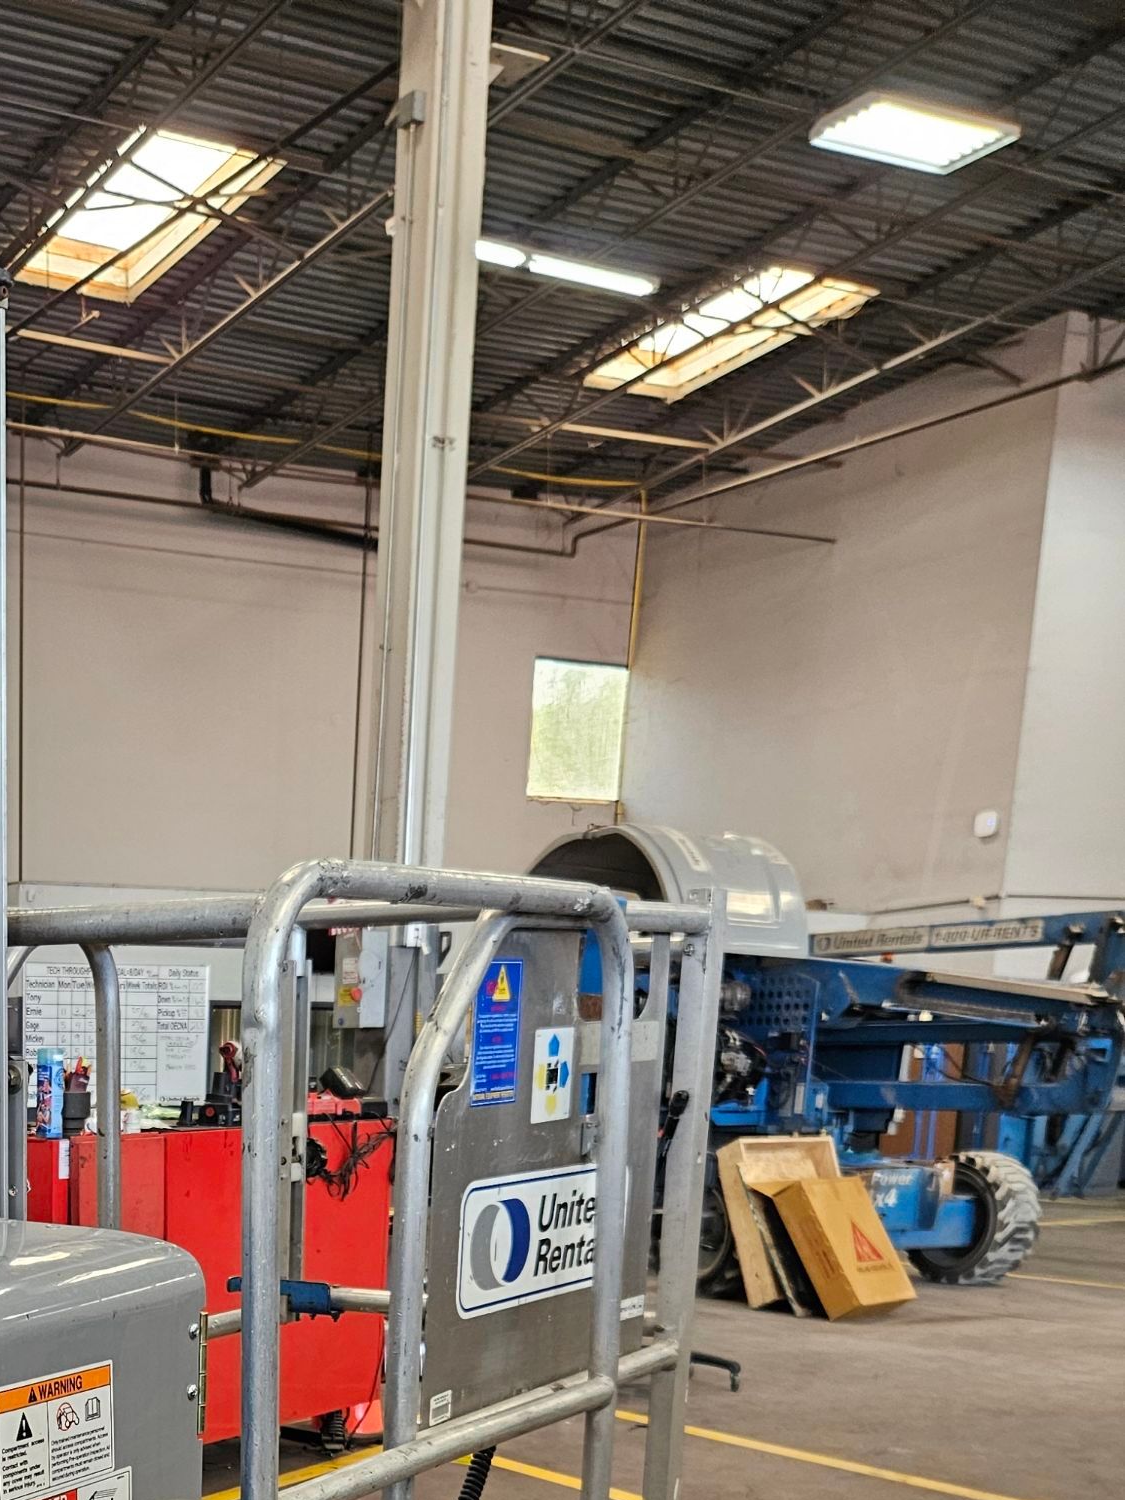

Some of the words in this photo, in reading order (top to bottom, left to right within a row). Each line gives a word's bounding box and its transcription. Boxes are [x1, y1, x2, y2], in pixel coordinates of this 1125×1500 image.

[833, 932, 874, 949] United
[876, 931, 923, 946] Rentals
[62, 966, 92, 975] THROUGHP
[168, 968, 180, 979] Daily
[182, 969, 198, 977] Status
[26, 979, 55, 988] Technician
[58, 980, 70, 988] Mon
[72, 980, 85, 989] Tue
[26, 993, 41, 1004] Tony
[871, 1170, 912, 1186] Power
[538, 1188, 596, 1232] Unite
[533, 1230, 594, 1277] Renta
[38, 1375, 82, 1400] WARNING
[2, 1442, 29, 1454] Compartment
[2, 1462, 18, 1471] Contact
[3, 1468, 28, 1479] components
